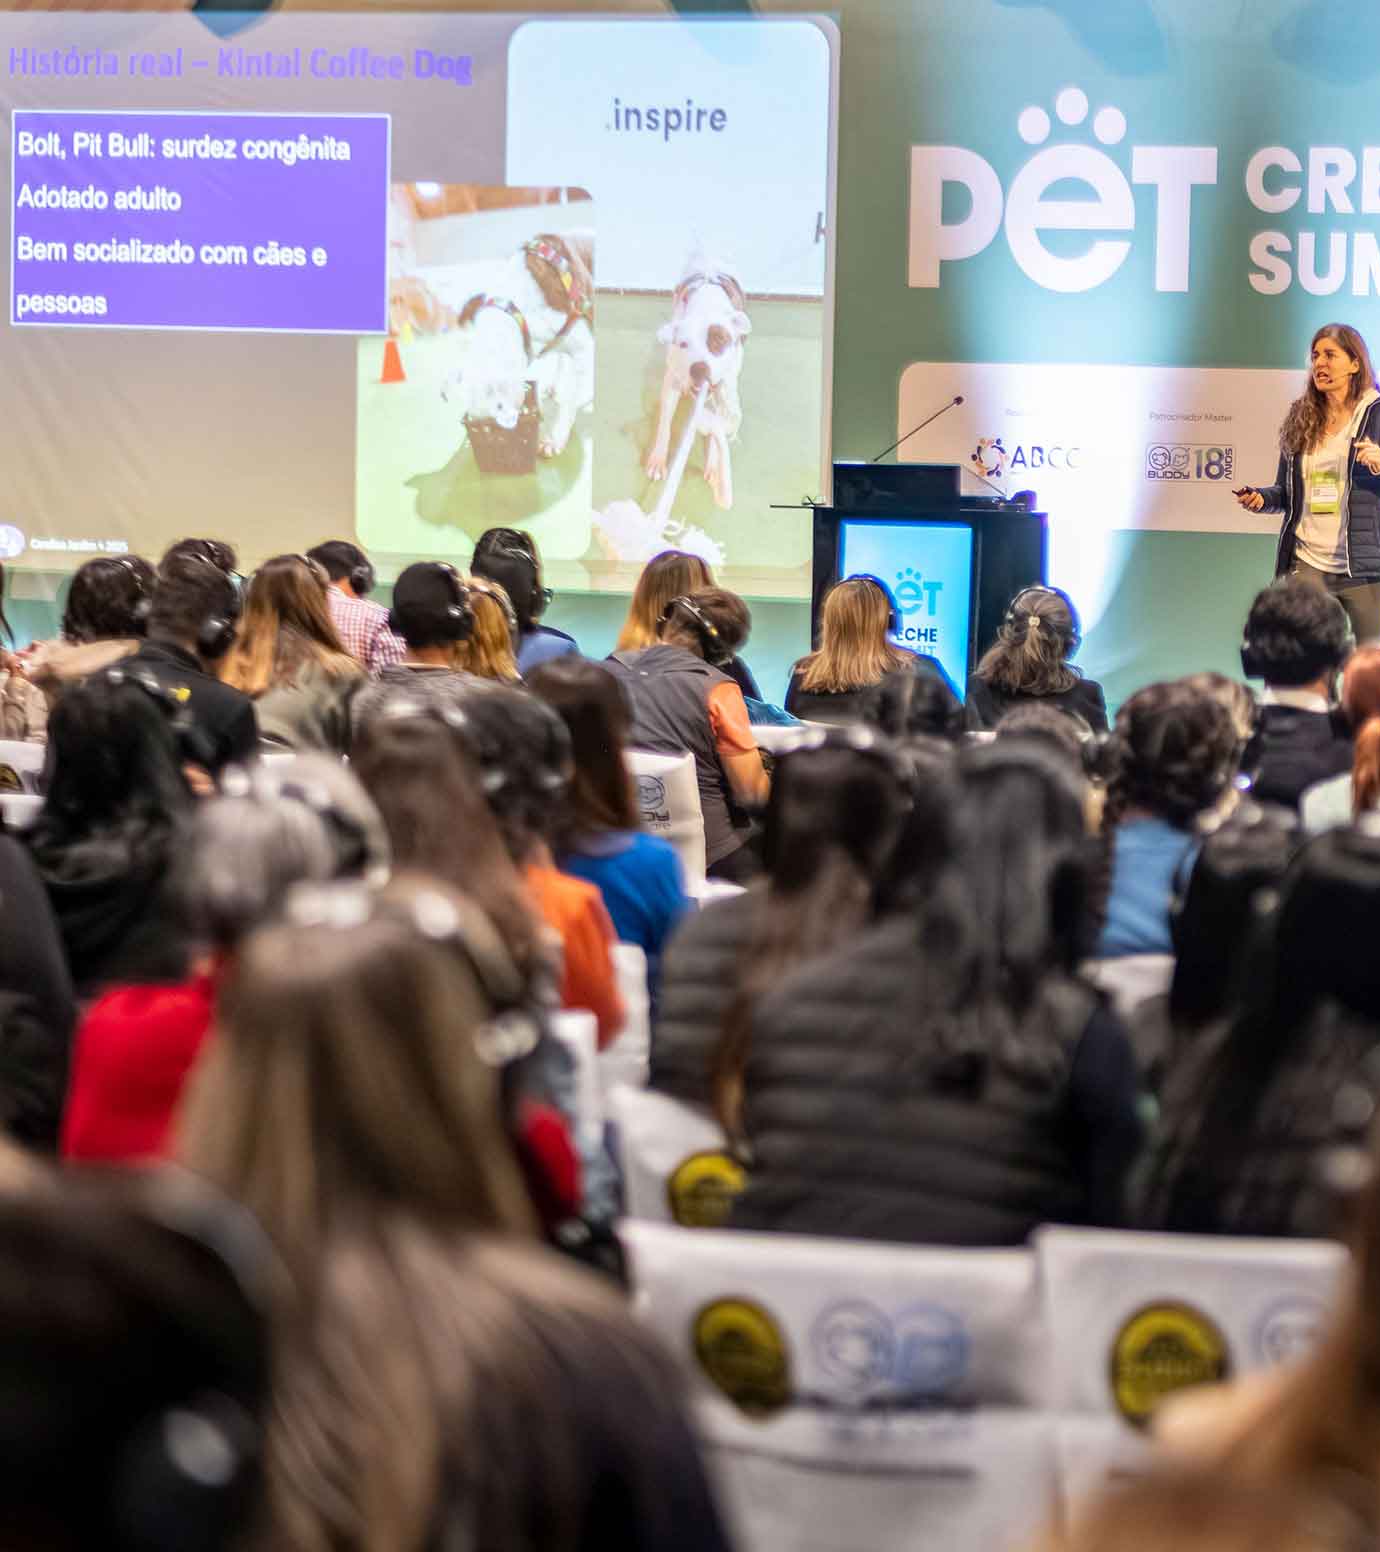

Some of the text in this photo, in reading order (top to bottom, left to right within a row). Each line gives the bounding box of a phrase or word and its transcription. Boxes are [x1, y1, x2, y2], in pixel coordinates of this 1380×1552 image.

[8, 46, 119, 78] História
[128, 47, 184, 78] real
[216, 47, 301, 79] Kintal
[309, 46, 405, 81] Coffee
[413, 48, 474, 86] Dog
[18, 131, 351, 166] Bolt, Pit Bull: surdez congênita
[17, 183, 182, 211] Adotado adulto
[17, 236, 328, 267] Bem socializado com cães e
[16, 294, 108, 319] pessoas
[1147, 470, 1191, 480] BUDDY
[1194, 447, 1225, 480] 18
